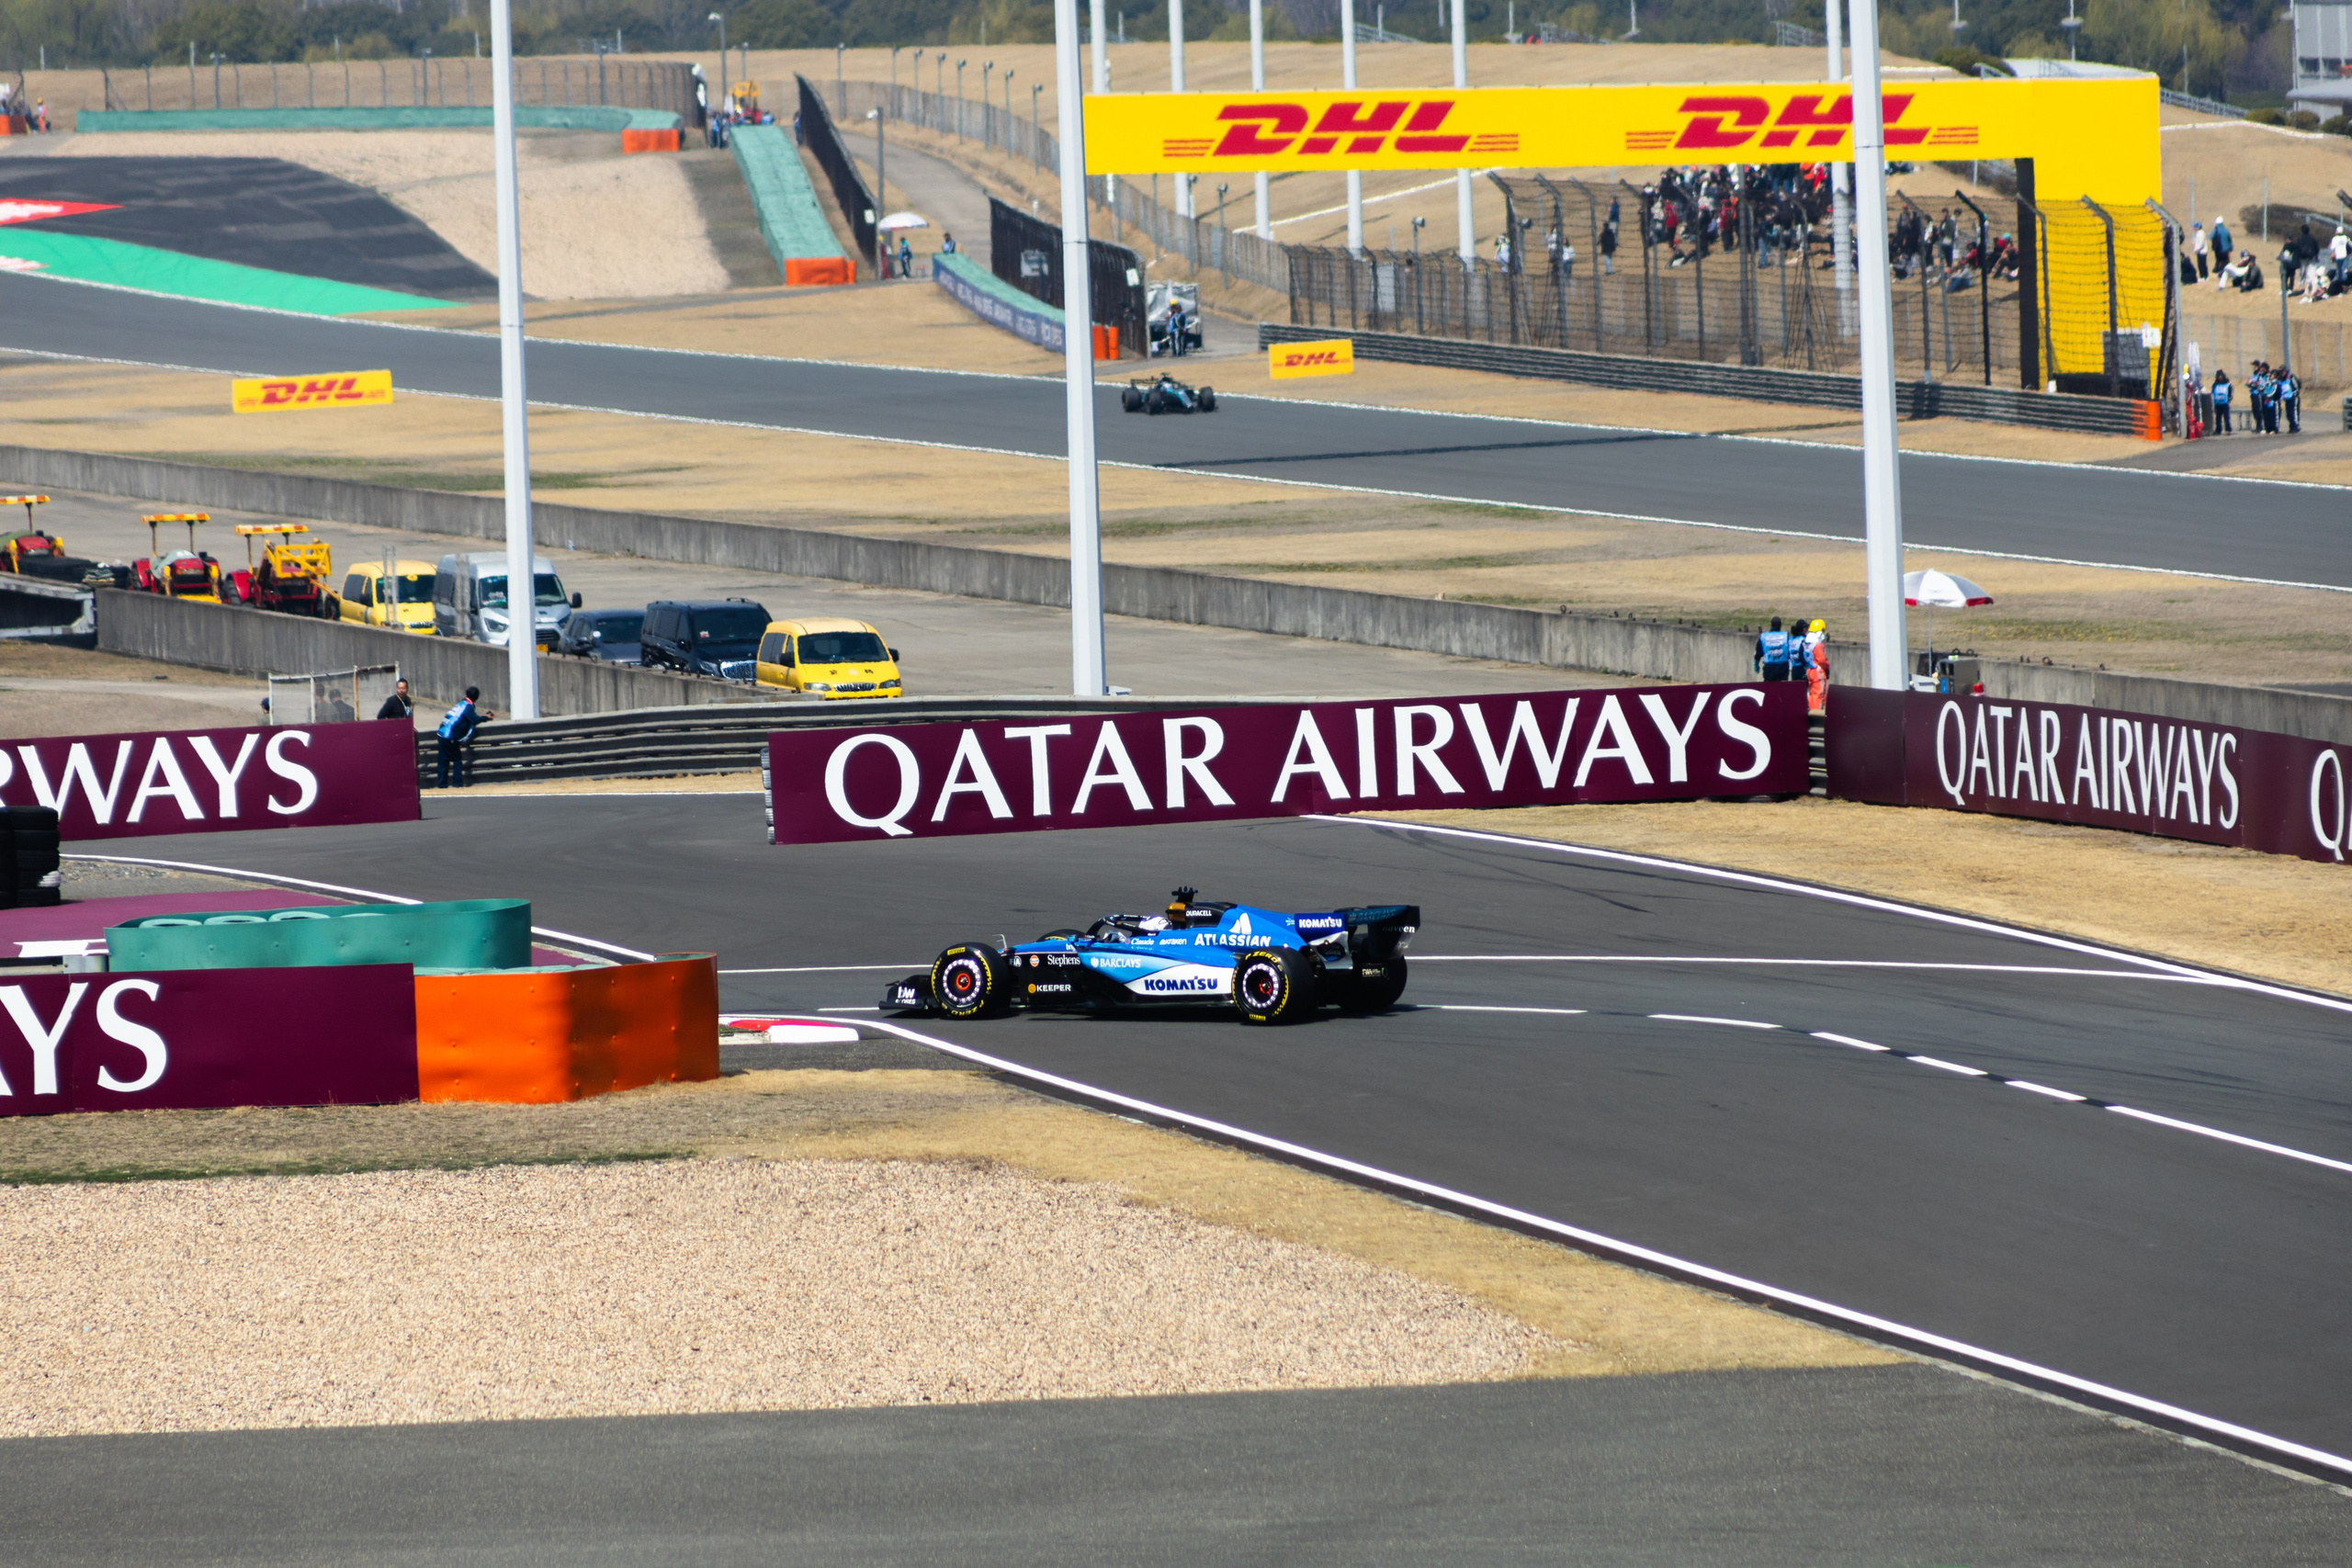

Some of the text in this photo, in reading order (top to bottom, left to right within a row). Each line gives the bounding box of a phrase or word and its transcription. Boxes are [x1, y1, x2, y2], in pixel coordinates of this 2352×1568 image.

[1213, 101, 1471, 156] DHL
[1674, 94, 1930, 149] DHL
[1284, 352, 1340, 367] DHL
[261, 378, 364, 405] DHL
[824, 688, 1772, 837] QATAR AIRWAYS
[1936, 700, 2239, 829] QATAR AIRWAYS
[2311, 749, 2352, 861] Q
[1298, 916, 1342, 929] KOMATSU
[1130, 937, 1155, 945] Claude
[1194, 932, 1272, 947] ATLASSIAN
[1047, 953, 1080, 967] Stephens
[1100, 957, 1141, 969] BARCLAYS
[1252, 951, 1279, 964] ZERO
[1036, 984, 1071, 992] KEEPER
[1144, 976, 1218, 991] KOMATSU
[0, 978, 167, 1097] YS
